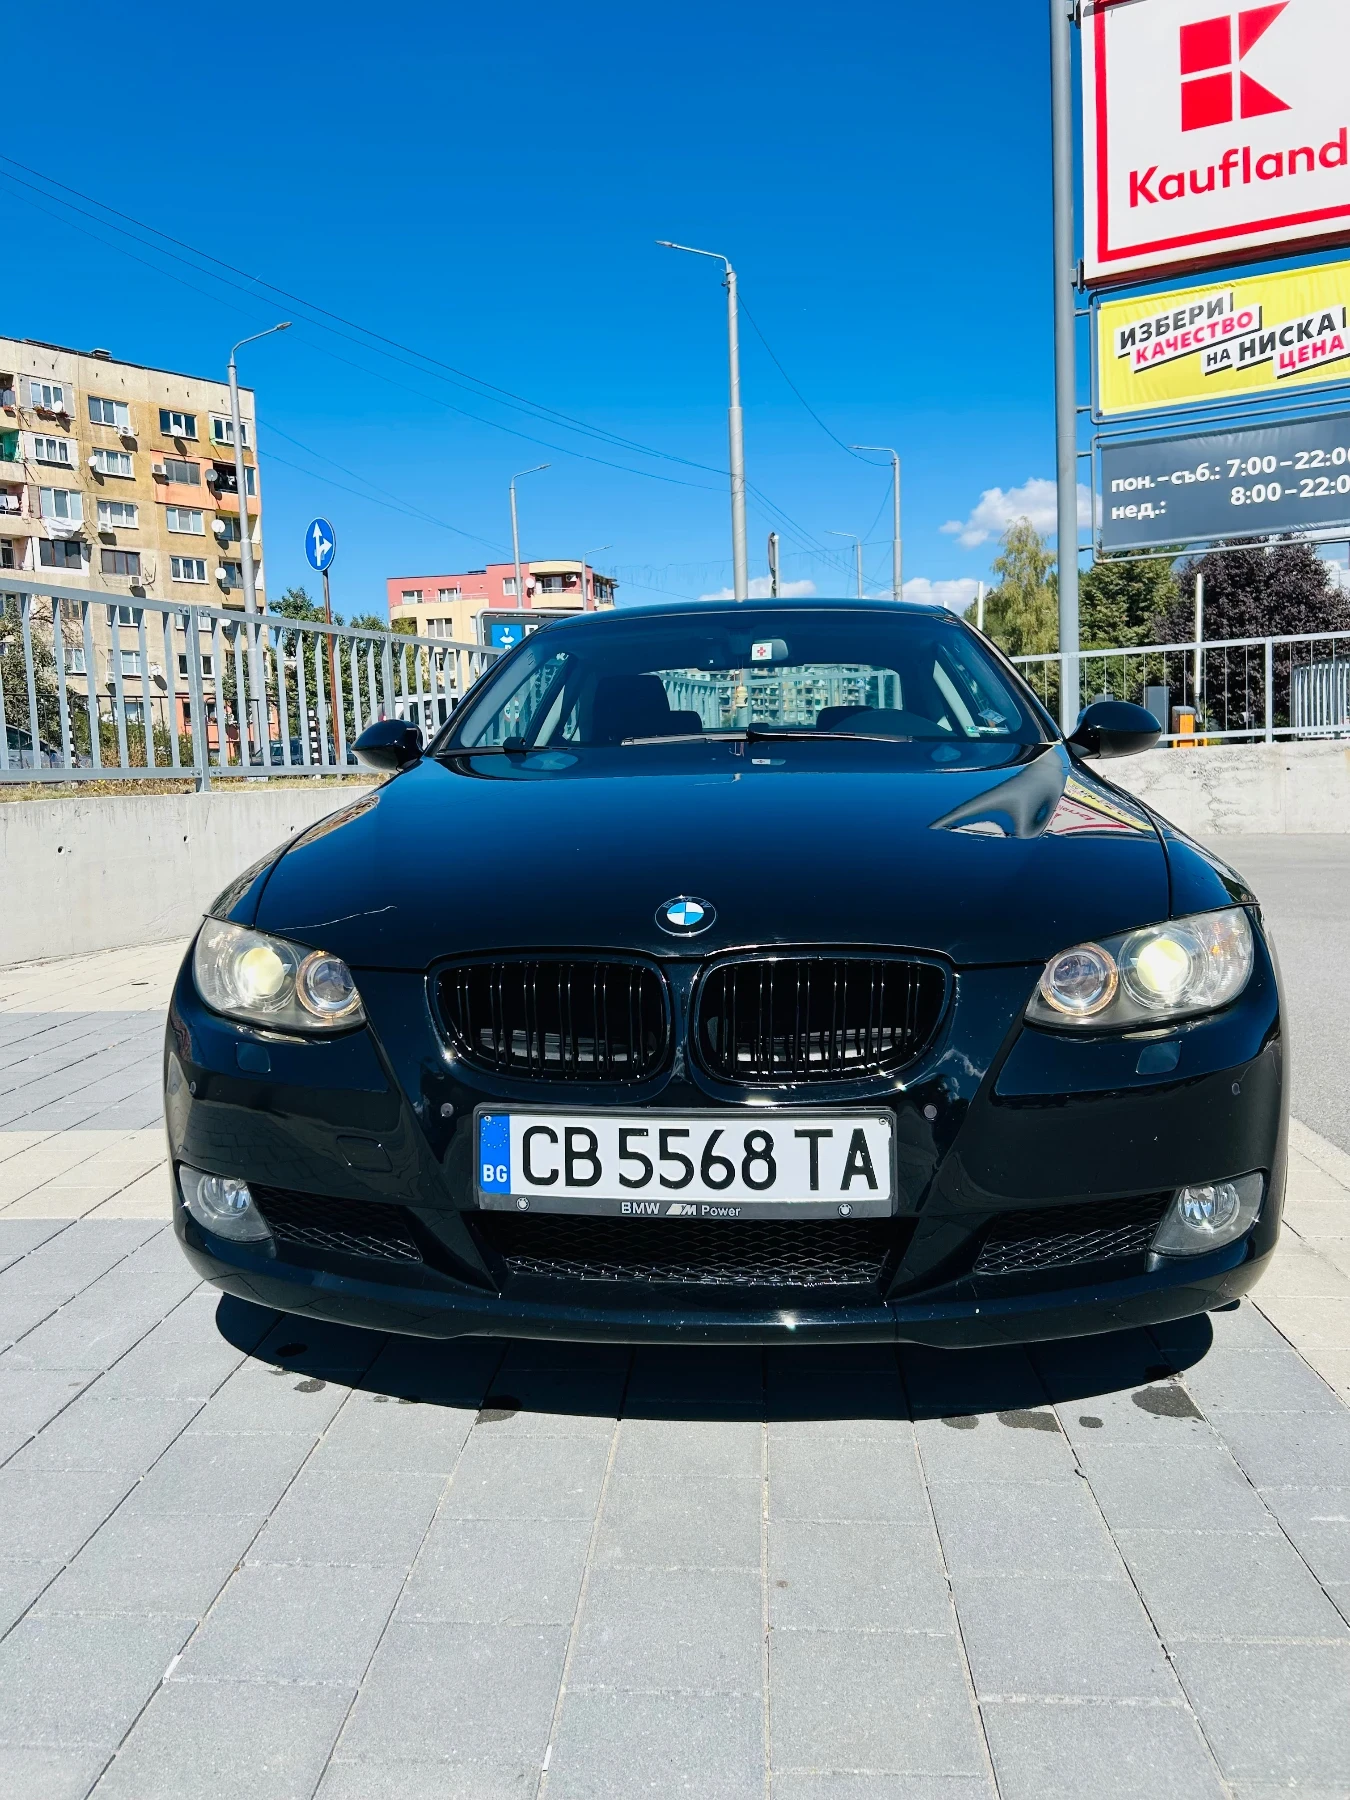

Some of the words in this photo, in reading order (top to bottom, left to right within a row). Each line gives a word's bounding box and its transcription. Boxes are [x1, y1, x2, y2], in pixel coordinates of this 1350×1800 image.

[1129, 127, 1348, 208] Kaufland
[1120, 296, 1224, 350] ИЗБЕРИ
[1136, 311, 1254, 365] КАЧЕСТВО
[1206, 348, 1231, 367] НА
[1239, 313, 1336, 361] НИСКА
[1279, 334, 1345, 369] ЦЕНА
[1226, 446, 1350, 478] 7:00–22:0
[1111, 500, 1166, 520] нед.:
[483, 1164, 508, 1183] BG
[522, 1125, 603, 1187] CB
[618, 1127, 777, 1191] 5568
[794, 1128, 878, 1191] TA
[621, 1202, 660, 1215] BMW
[701, 1205, 741, 1217] Power
